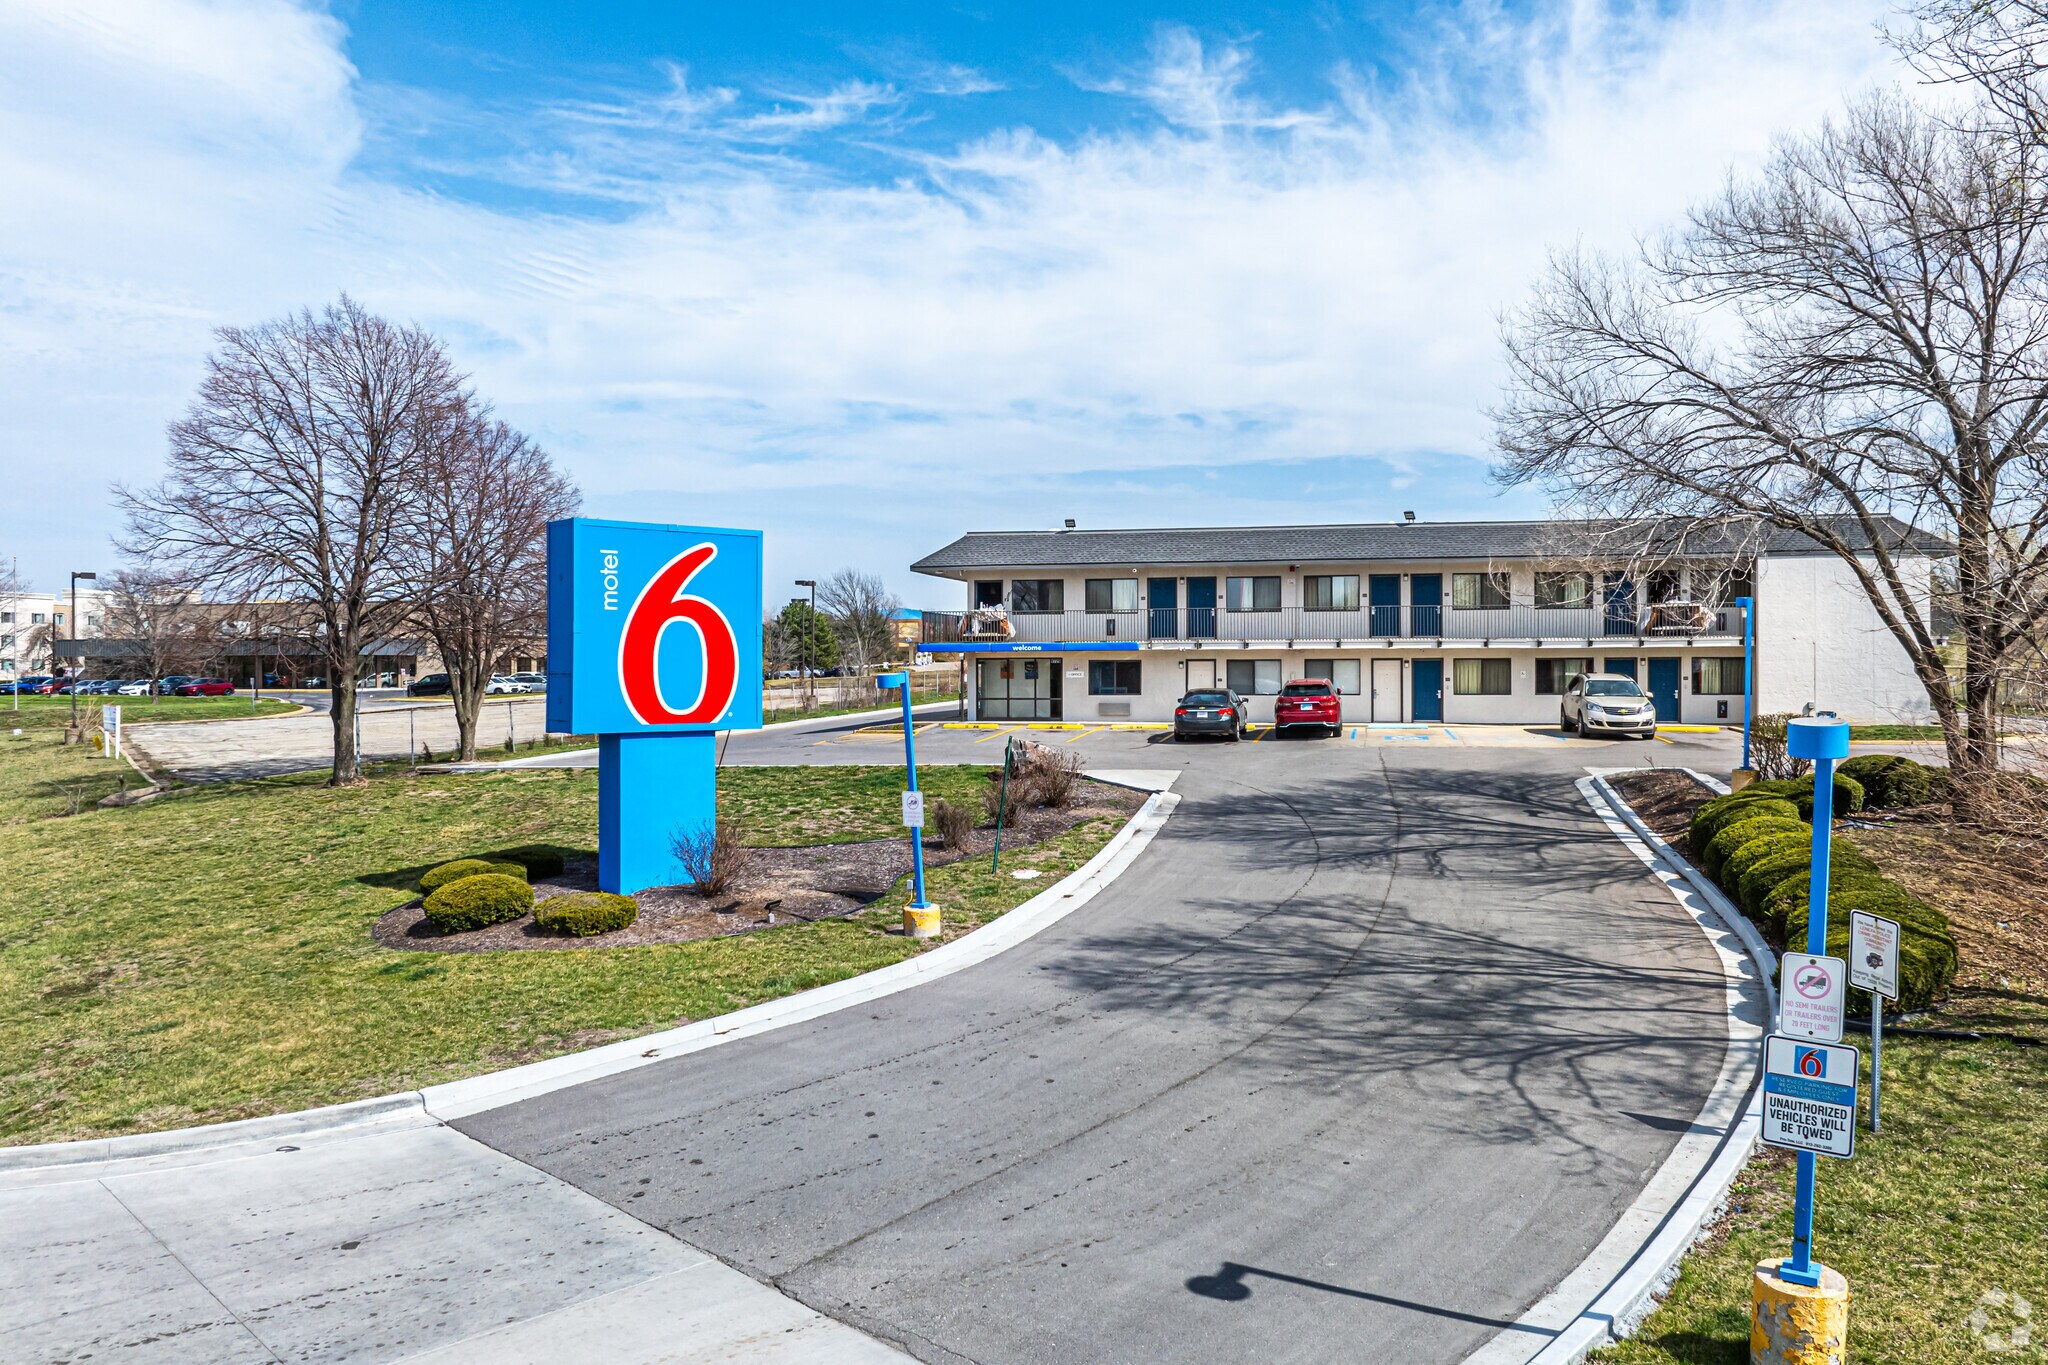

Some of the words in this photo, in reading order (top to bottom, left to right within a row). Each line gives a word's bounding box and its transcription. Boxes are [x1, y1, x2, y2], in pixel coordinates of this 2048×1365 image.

[600, 549, 618, 610] motel
[618, 542, 739, 725] 6
[1794, 1010, 1821, 1021] TRAILERS
[1795, 1001, 1809, 1009] SEMI
[1810, 1003, 1838, 1013] TRAILERS
[1800, 1021, 1813, 1029] FEET
[1800, 1049, 1822, 1077] 6
[1771, 1076, 1803, 1086] RESERVED
[1804, 1081, 1833, 1091] PARKING
[1778, 1082, 1817, 1092] REGISTERED
[1819, 1088, 1839, 1096] GUEST
[1783, 1088, 1820, 1098] EMPLOYEES
[1769, 1096, 1847, 1120] UNAUTHORIZED
[1769, 1108, 1817, 1127] VEHICLES
[1821, 1117, 1846, 1132] WILL
[1781, 1122, 1793, 1133] BE
[1796, 1125, 1832, 1141] TOWED
